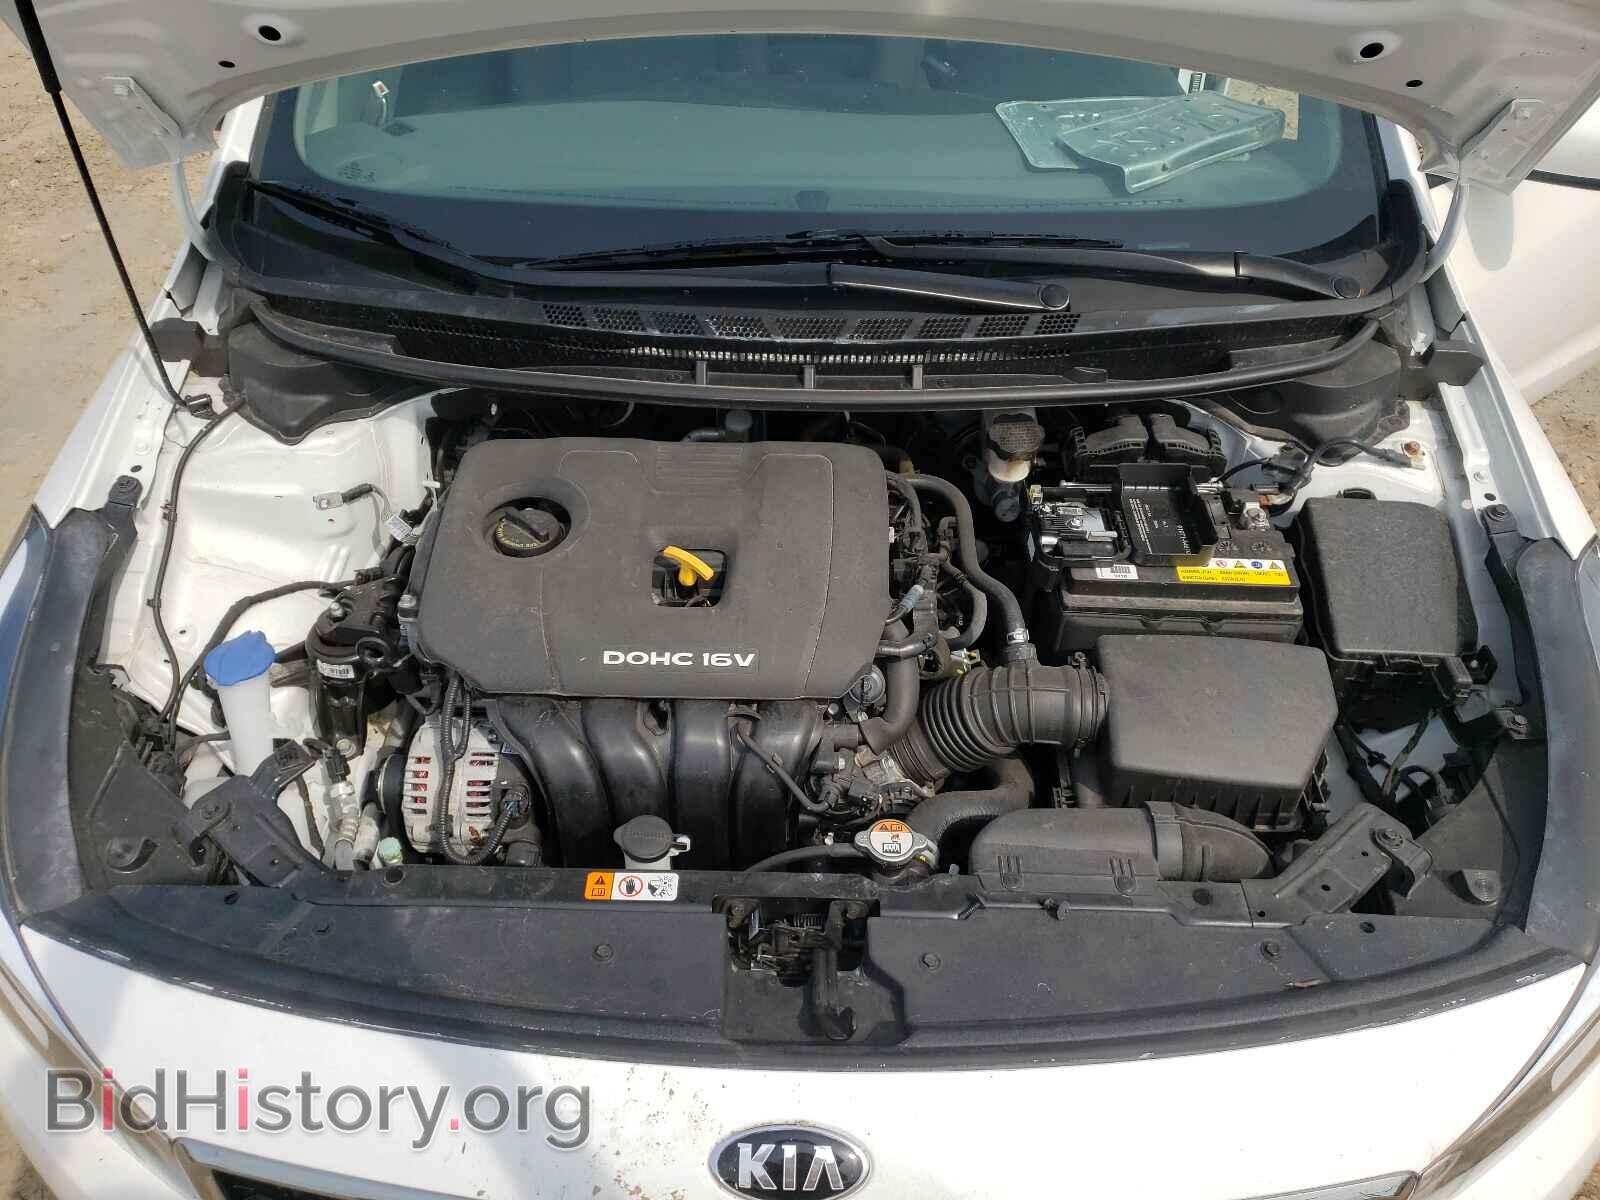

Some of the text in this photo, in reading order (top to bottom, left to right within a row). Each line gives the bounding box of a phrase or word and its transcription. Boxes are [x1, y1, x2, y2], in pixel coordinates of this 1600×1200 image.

[603, 651, 755, 667] DOHC 16V
[738, 1143, 844, 1191] KIA
